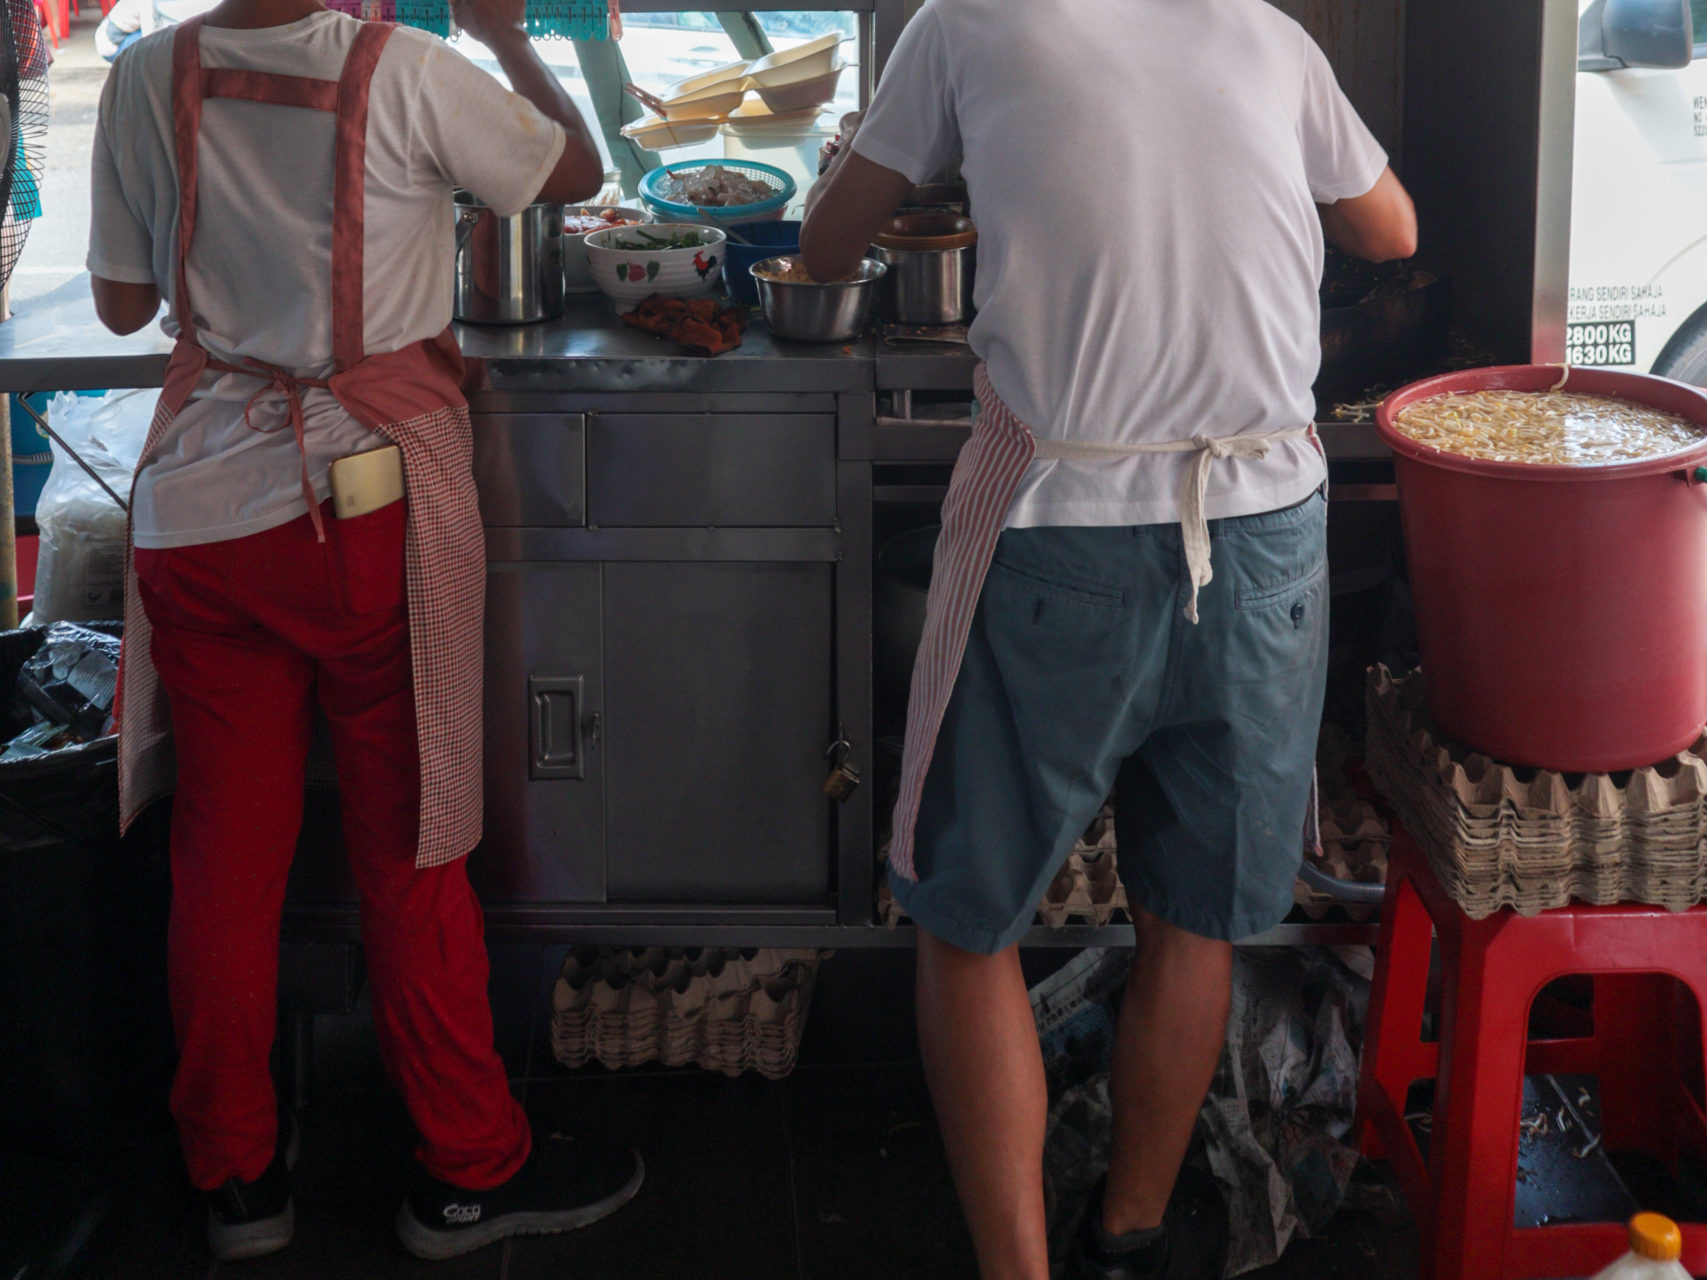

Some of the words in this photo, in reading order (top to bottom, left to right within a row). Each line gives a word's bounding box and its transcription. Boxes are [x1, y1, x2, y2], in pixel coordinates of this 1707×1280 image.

[1596, 286, 1628, 301] SENDIRI
[1630, 284, 1663, 300] SAHAJA
[1599, 304, 1632, 320] SENDIRI
[1634, 303, 1667, 318] SAHAJA
